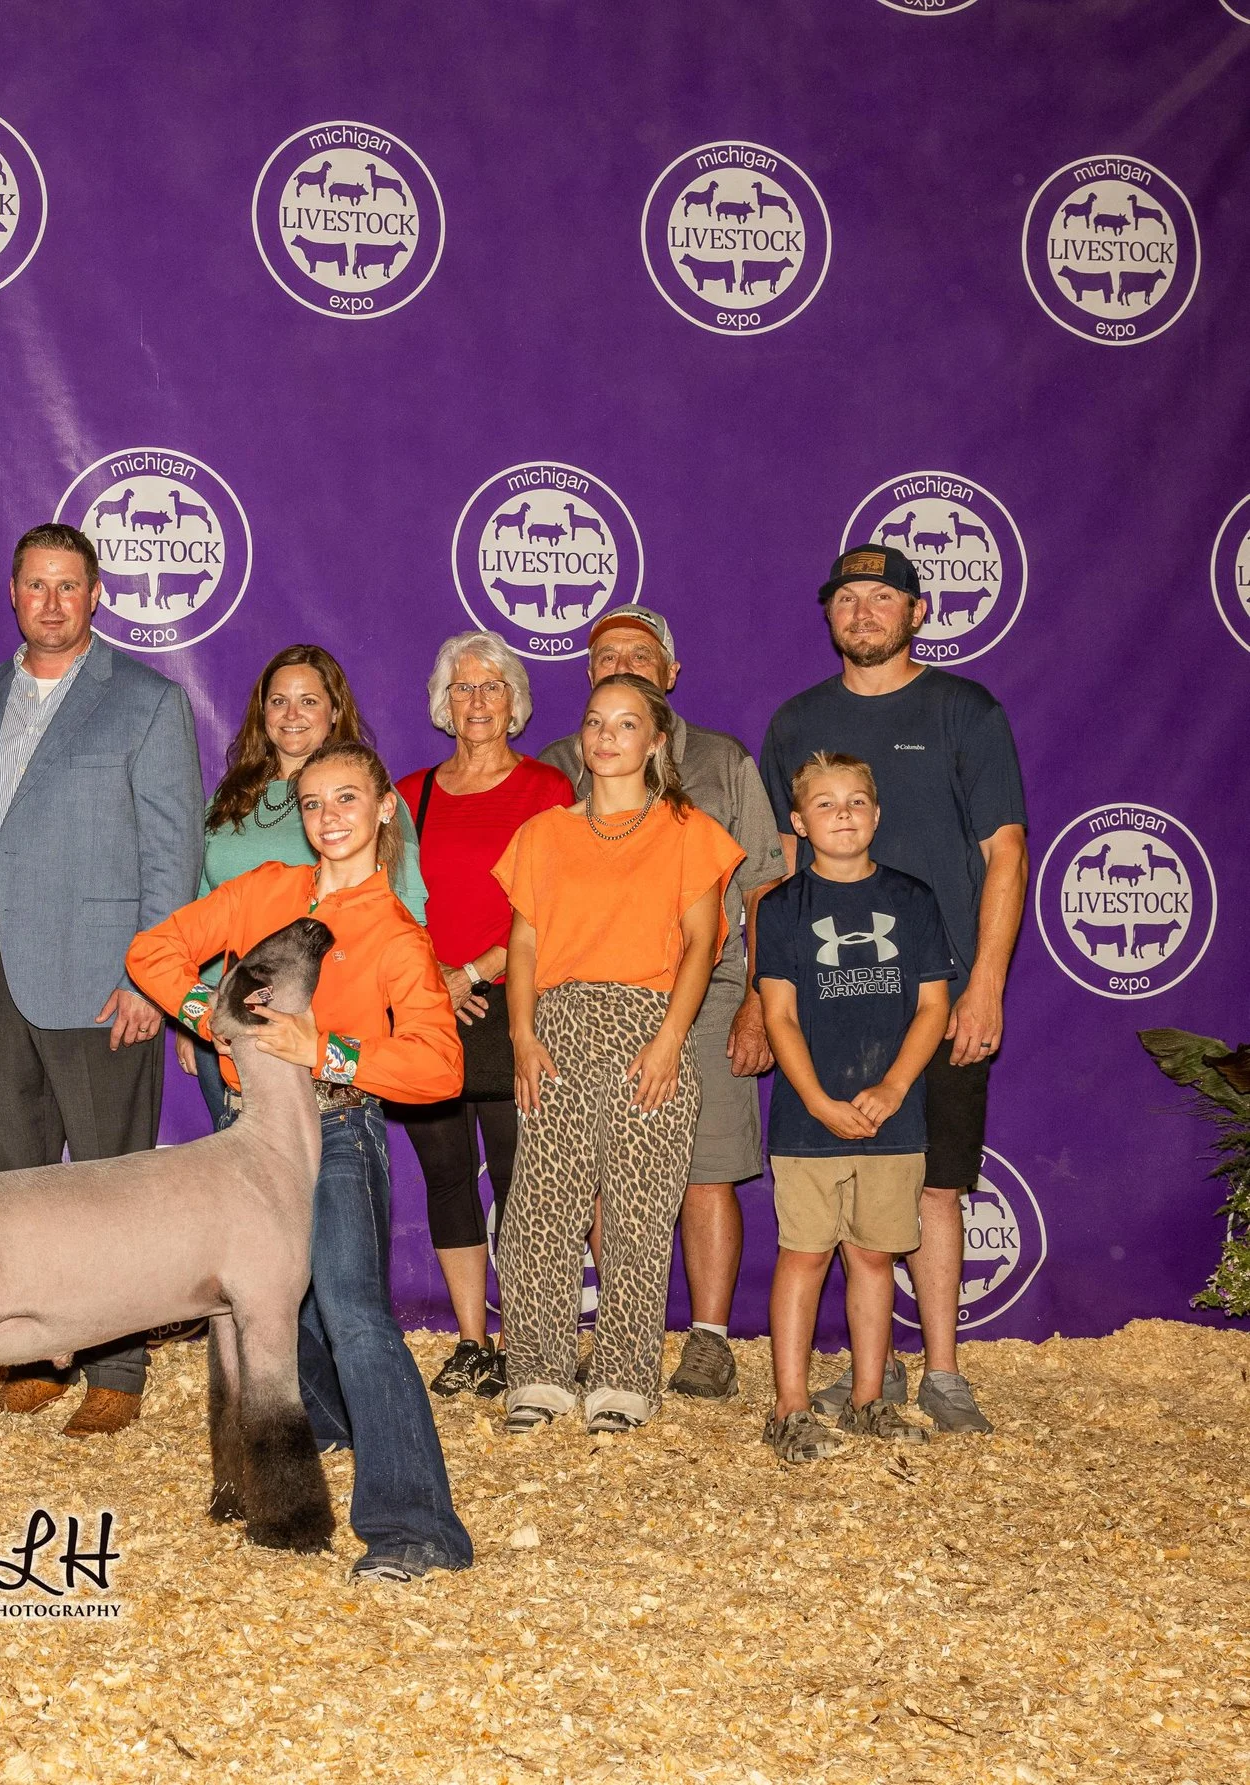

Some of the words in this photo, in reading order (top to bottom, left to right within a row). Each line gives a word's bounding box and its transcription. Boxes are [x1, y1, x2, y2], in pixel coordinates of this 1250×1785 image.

[309, 127, 391, 154] michigan
[697, 146, 777, 171] michigan
[1074, 160, 1151, 185] michigan
[282, 207, 415, 235] LIVESTOCK
[671, 227, 802, 251] LIVESTOCK
[1051, 239, 1174, 263] LIVESTOCK
[330, 296, 373, 314] expo
[717, 313, 760, 330] expo
[1096, 323, 1135, 340] expo
[111, 453, 196, 480] michigan
[508, 467, 588, 493] michigan
[894, 477, 973, 501] michigan
[96, 538, 221, 563] IVESTOCK
[482, 550, 614, 574] LIVESTOCK
[911, 559, 999, 581] ESTOCK
[131, 628, 177, 646] expo
[530, 638, 573, 655] expo
[916, 644, 959, 660] expo
[1089, 809, 1166, 833] michigan
[1064, 892, 1189, 913] LIVESTOCK
[817, 967, 900, 987] UNDER
[1110, 977, 1149, 994] expo
[819, 982, 901, 999] ARMOUR
